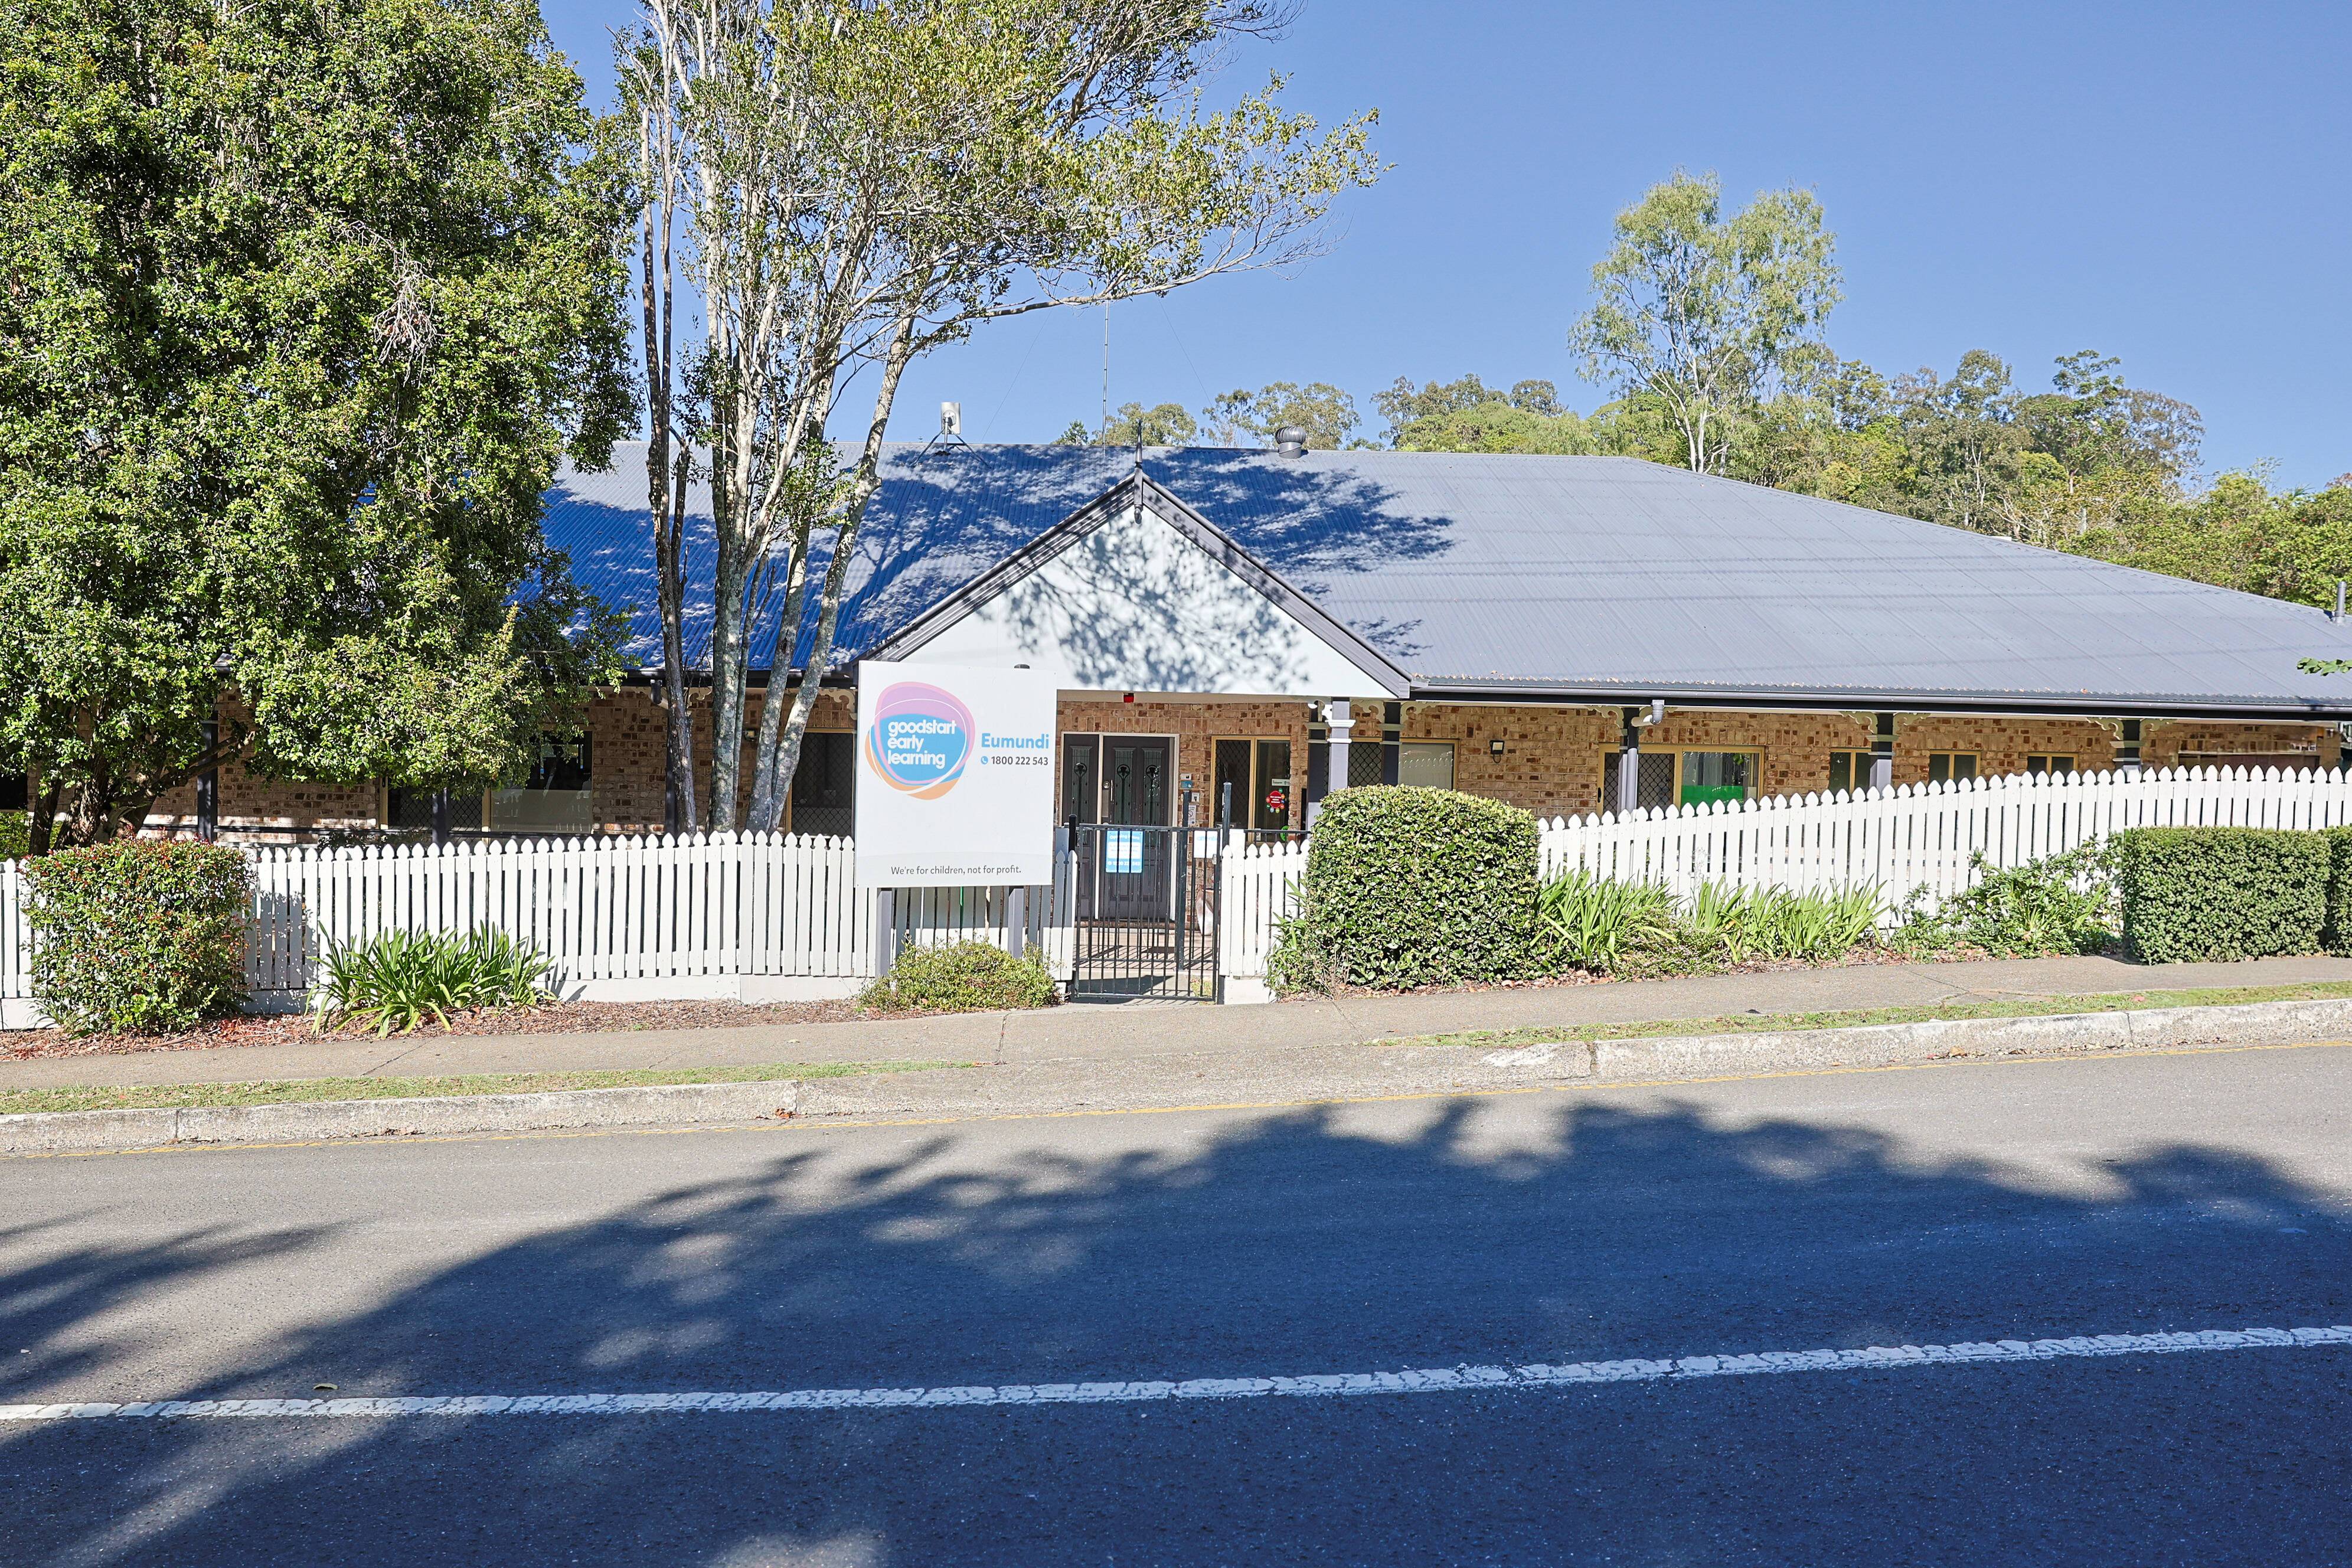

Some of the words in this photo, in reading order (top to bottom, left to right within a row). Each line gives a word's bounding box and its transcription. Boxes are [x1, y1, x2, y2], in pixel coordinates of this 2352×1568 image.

[888, 719, 956, 737] goodstart
[887, 734, 925, 752] early
[981, 733, 1049, 749] Eumundi
[887, 750, 946, 769] learning
[991, 756, 1014, 765] 1800
[1015, 756, 1030, 765] 222
[1033, 757, 1048, 766] 543
[891, 866, 914, 875] We're
[916, 865, 929, 874] for
[930, 865, 965, 876] children,
[967, 866, 981, 874] not
[983, 865, 995, 874] for
[997, 865, 1021, 876] profit.
